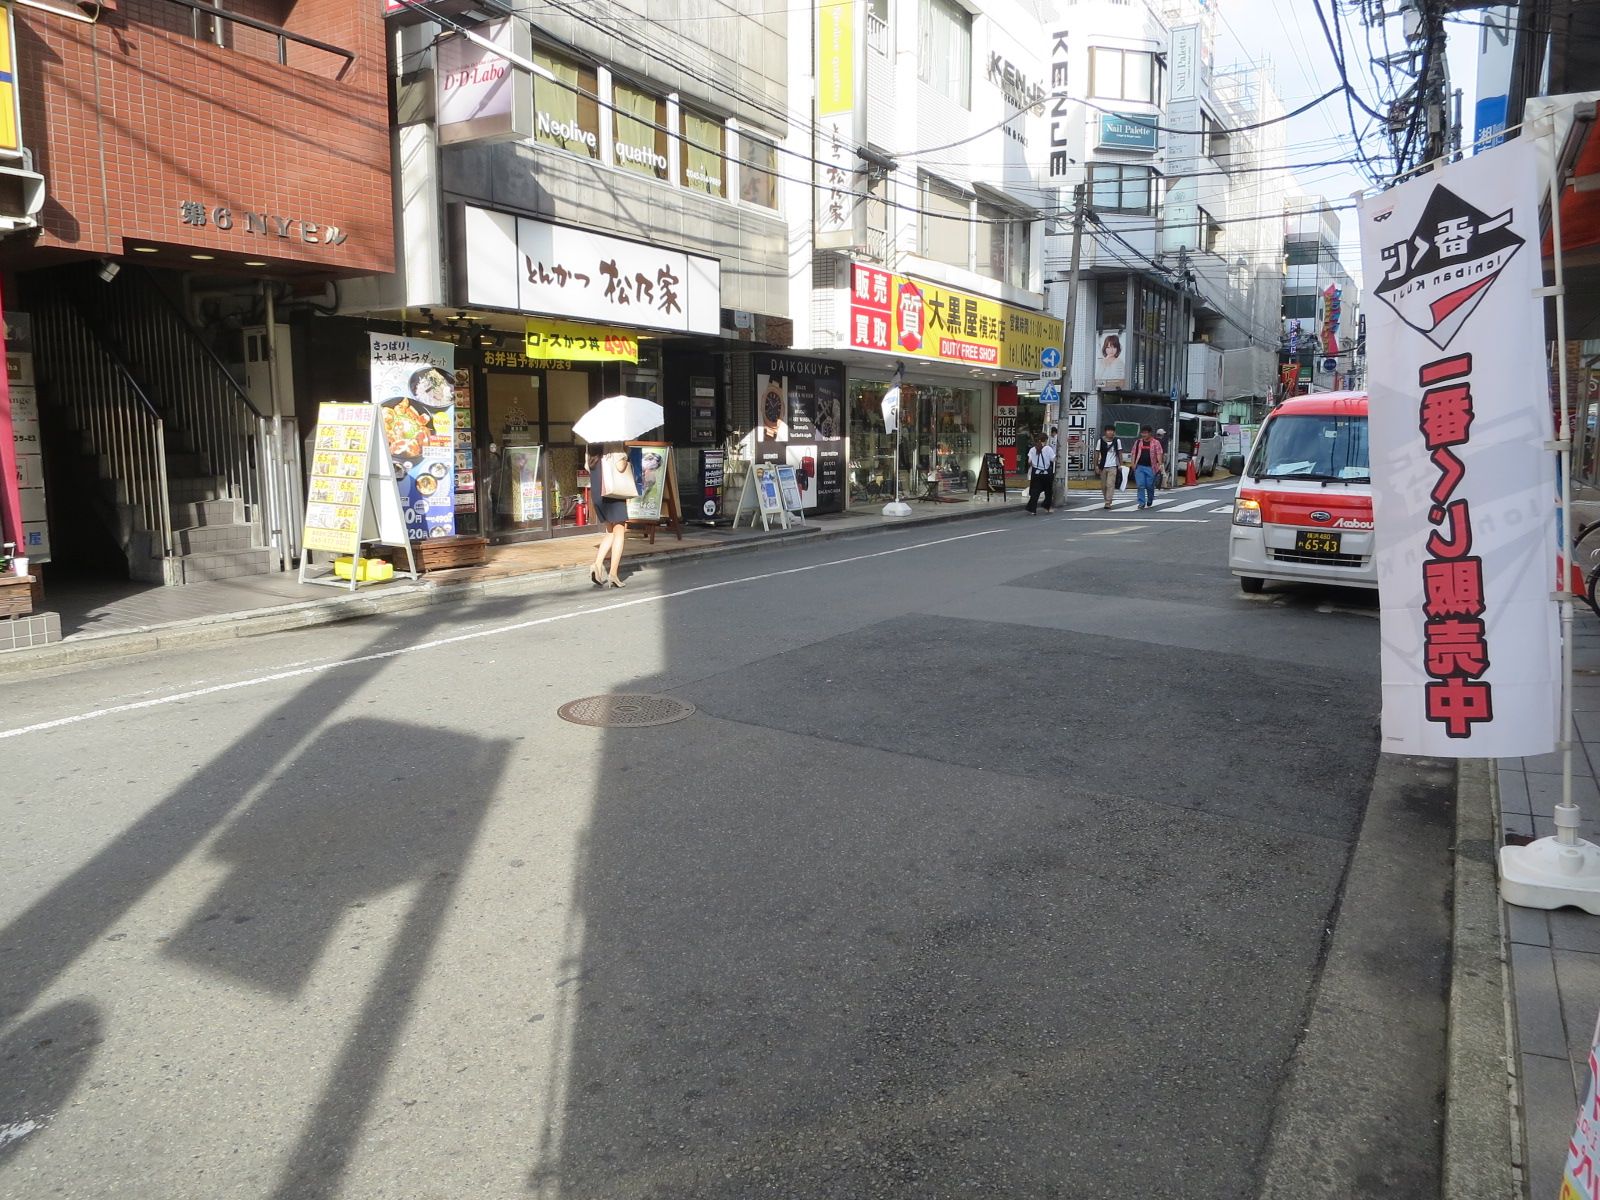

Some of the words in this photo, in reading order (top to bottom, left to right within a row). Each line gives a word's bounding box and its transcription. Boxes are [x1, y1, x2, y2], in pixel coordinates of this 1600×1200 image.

[537, 111, 597, 148] Neolive
[1106, 123, 1123, 134] Nail
[1125, 124, 1151, 136] Palette
[616, 141, 667, 170] quattro
[525, 254, 591, 288] とんかつ
[600, 258, 682, 315] 松乃家
[855, 268, 888, 304] 販売
[900, 292, 922, 340] 質
[928, 290, 978, 339] 大黒屋
[979, 315, 1006, 342] 横浜店
[855, 313, 888, 347] 買取
[527, 331, 601, 352] ロースかつ丼
[941, 340, 960, 356] DUTY
[961, 343, 979, 360] FREE
[979, 346, 996, 361] SHOP
[770, 359, 830, 376] DAIKOKUYA
[998, 417, 1016, 427] DUTY
[999, 407, 1016, 417] 免税
[998, 427, 1016, 437] FREE
[998, 437, 1016, 446] SHOP
[1304, 539, 1338, 552] 65-43
